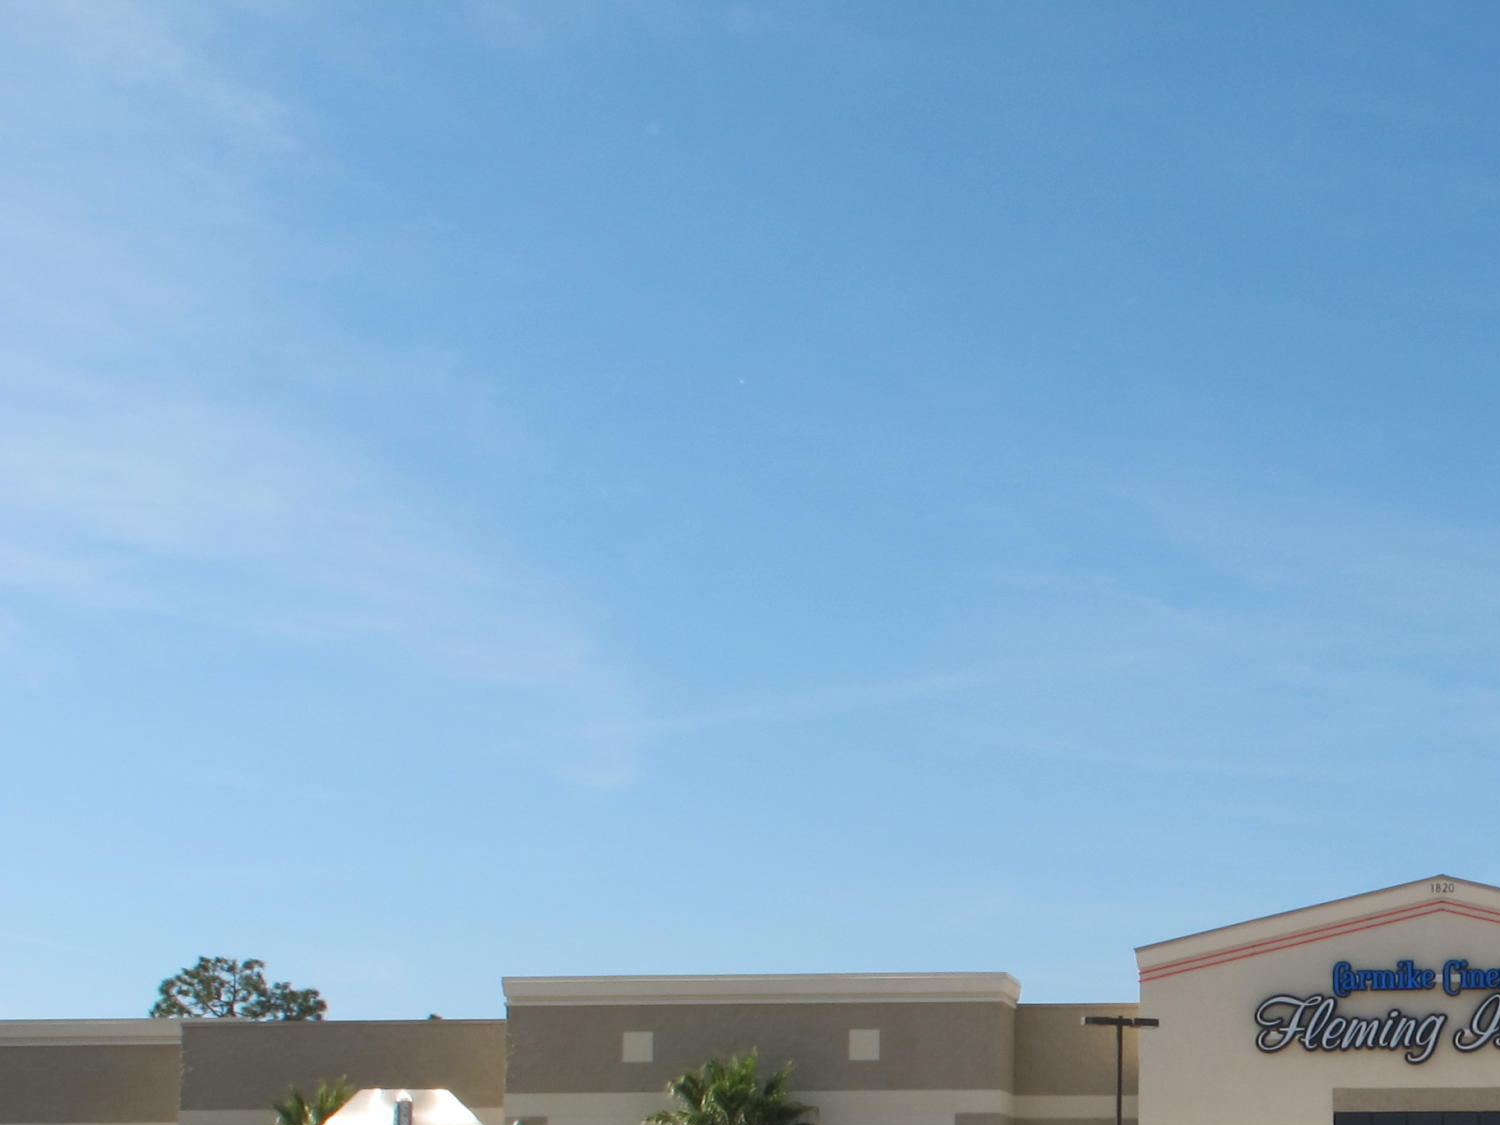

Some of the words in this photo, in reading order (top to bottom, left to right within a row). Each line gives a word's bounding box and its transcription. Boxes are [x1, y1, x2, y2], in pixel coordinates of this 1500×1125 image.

[1431, 882, 1455, 894] 1820
[1332, 960, 1437, 998] Carmike
[1254, 993, 1449, 1064] Fleming
